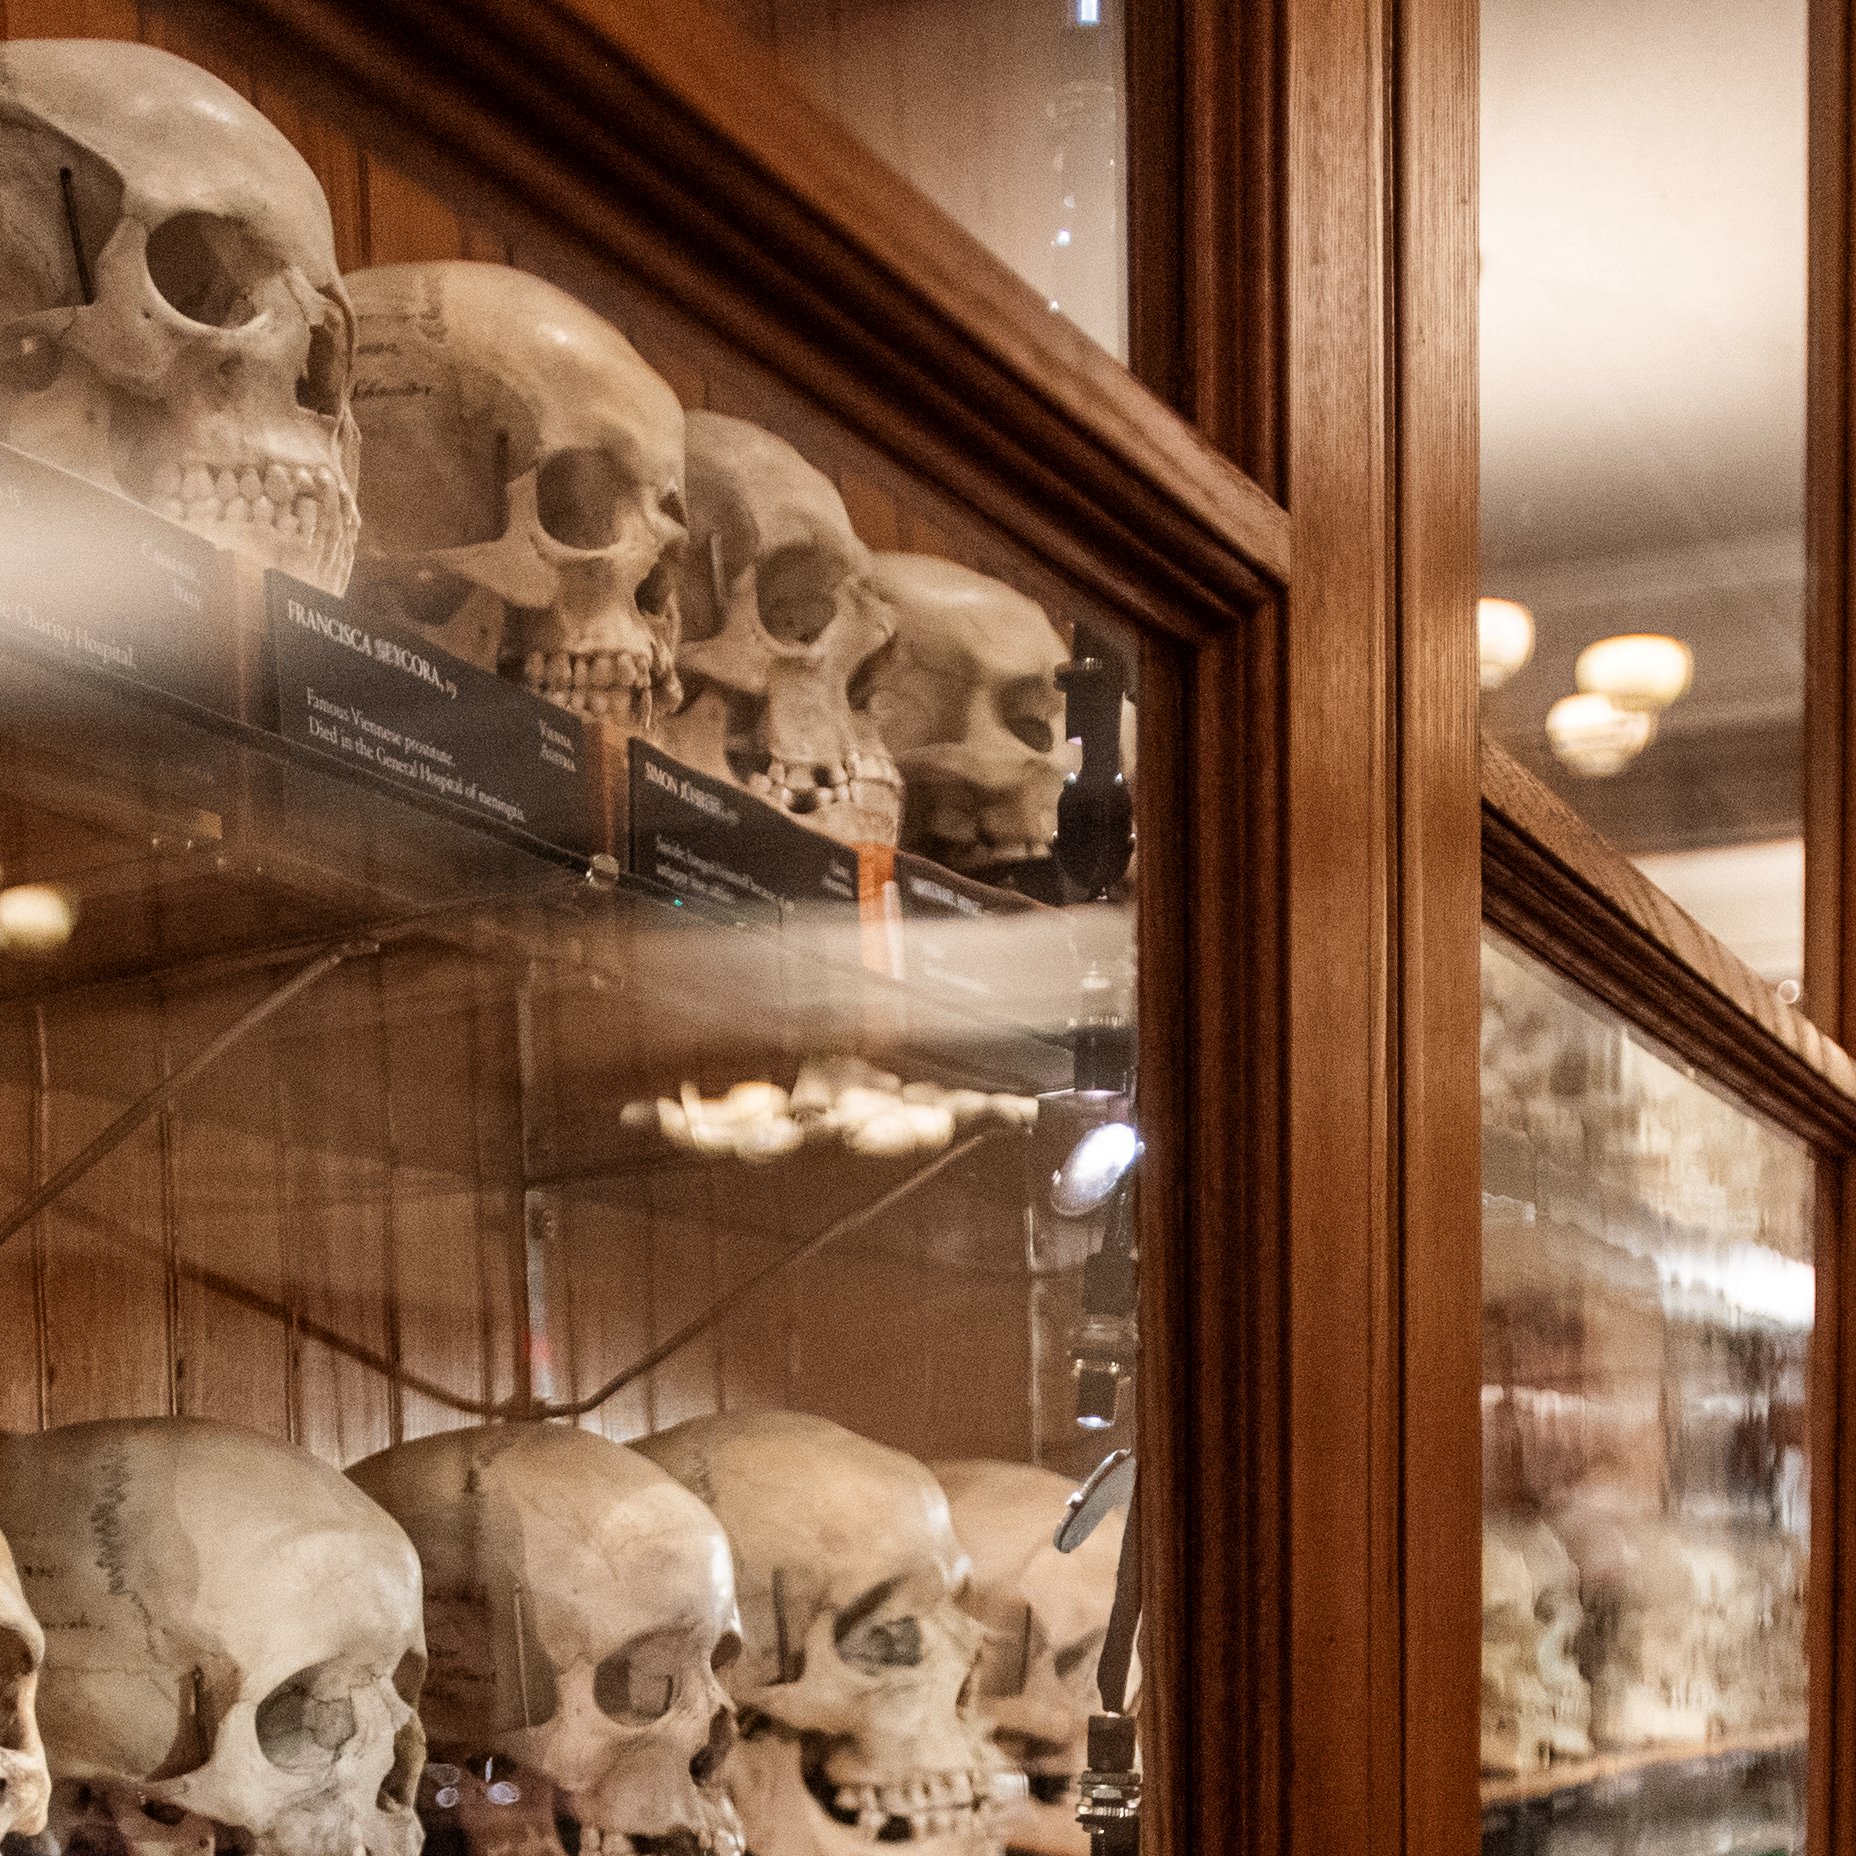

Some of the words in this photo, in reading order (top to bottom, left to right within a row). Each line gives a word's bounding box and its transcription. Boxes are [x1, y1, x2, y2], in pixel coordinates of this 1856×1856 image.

[14, 602, 72, 649] Charity
[286, 598, 373, 658] FRANCISCA
[307, 714, 339, 745] Died
